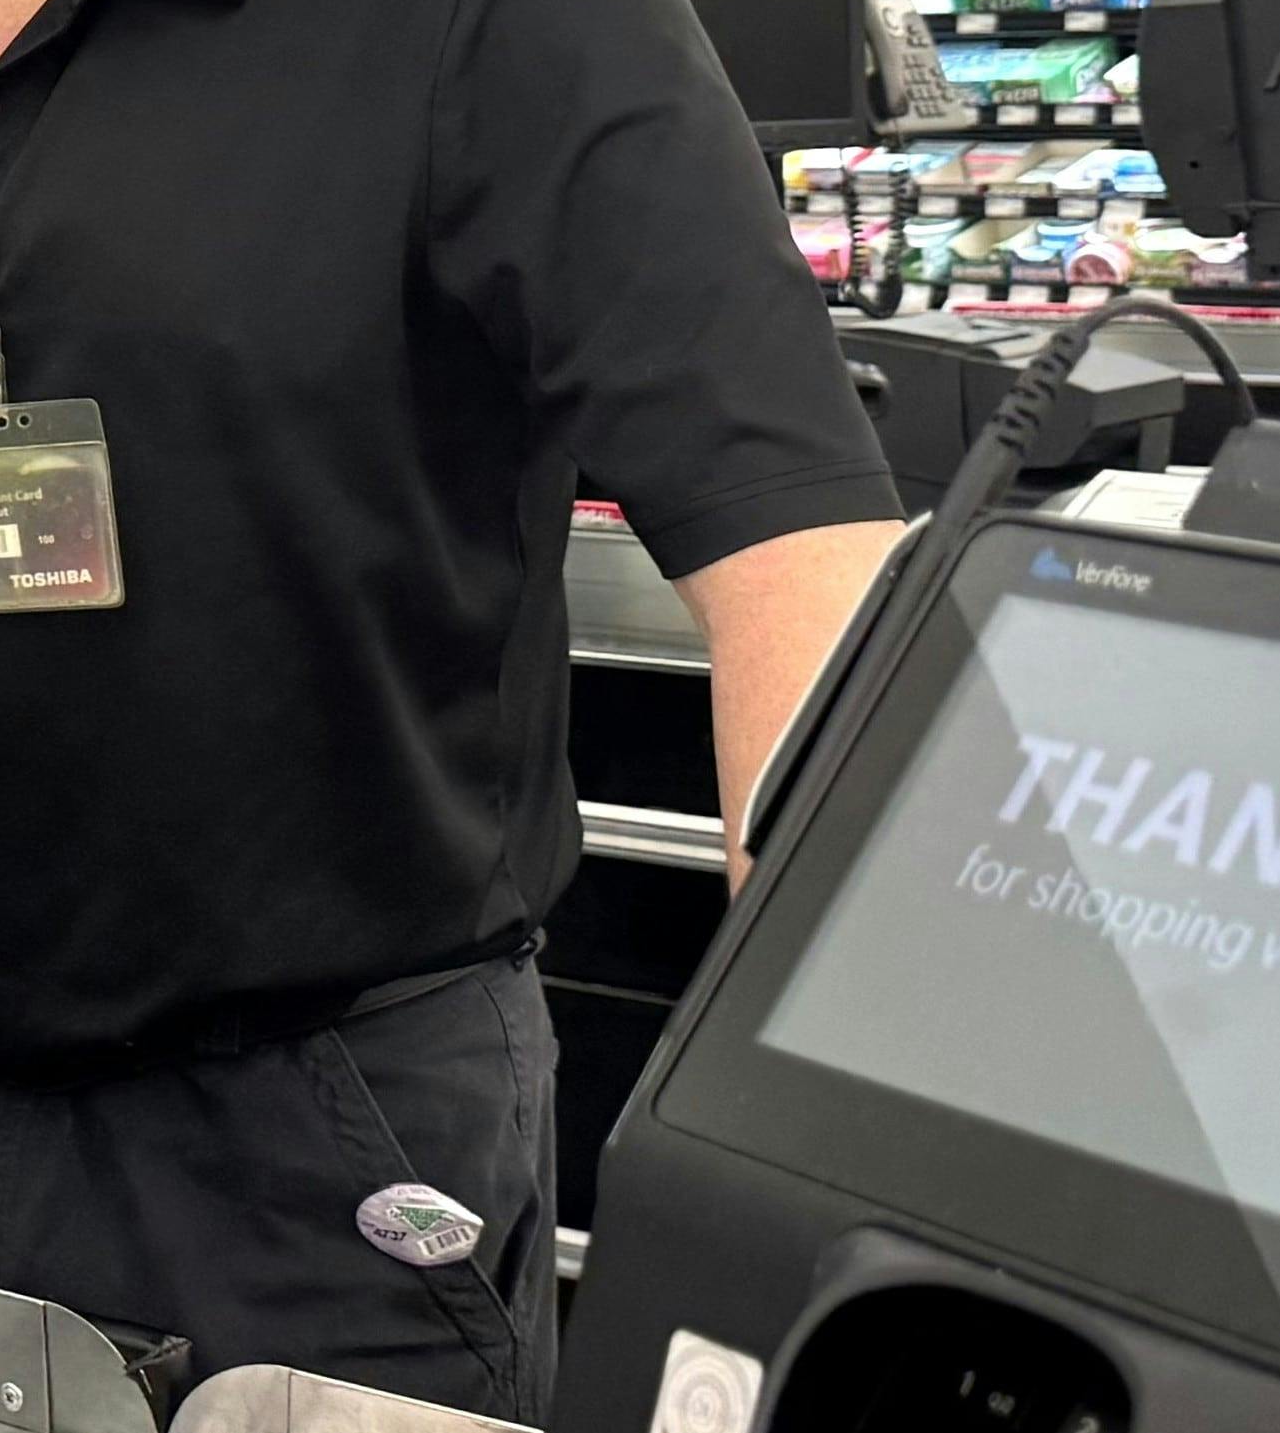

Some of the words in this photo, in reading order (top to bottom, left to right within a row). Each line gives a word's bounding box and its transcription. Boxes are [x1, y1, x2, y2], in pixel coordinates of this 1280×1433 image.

[15, 487, 43, 502] Card
[10, 568, 93, 589] TOSHIBA
[954, 843, 1028, 895] for
[1027, 867, 1252, 970] shopping
